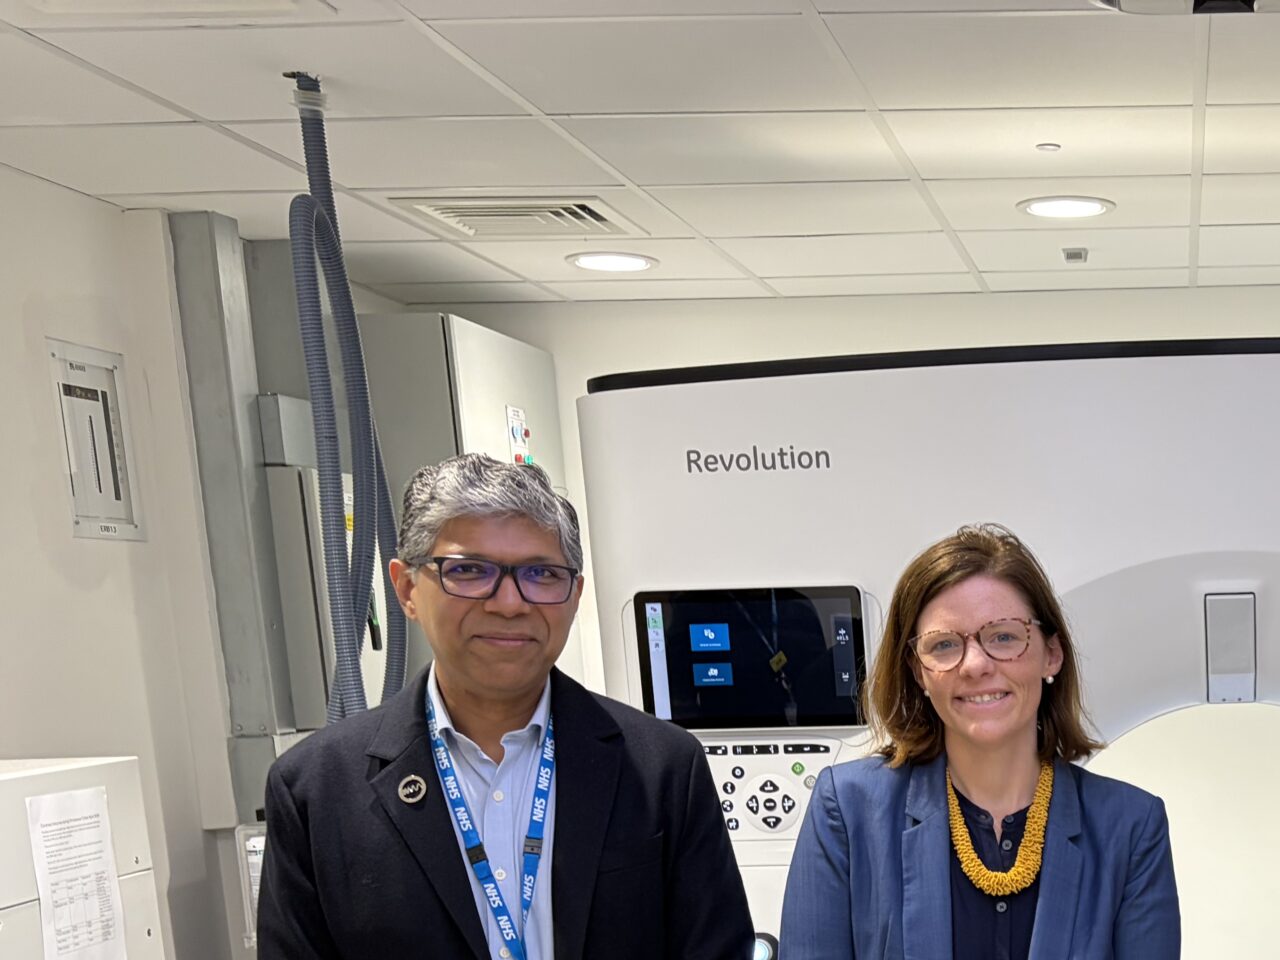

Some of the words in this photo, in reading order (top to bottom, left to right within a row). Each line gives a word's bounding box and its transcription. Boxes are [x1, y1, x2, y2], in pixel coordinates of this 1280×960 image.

[686, 445, 830, 473] Revolution
[434, 747, 450, 770] NHS
[543, 737, 555, 761] NHS
[444, 776, 461, 800] NHS
[538, 766, 551, 791] NHS
[454, 807, 472, 832] NHS
[532, 797, 546, 822] NHS
[483, 883, 503, 908] NHS
[523, 874, 534, 901] NHS
[497, 915, 516, 941] NHS
